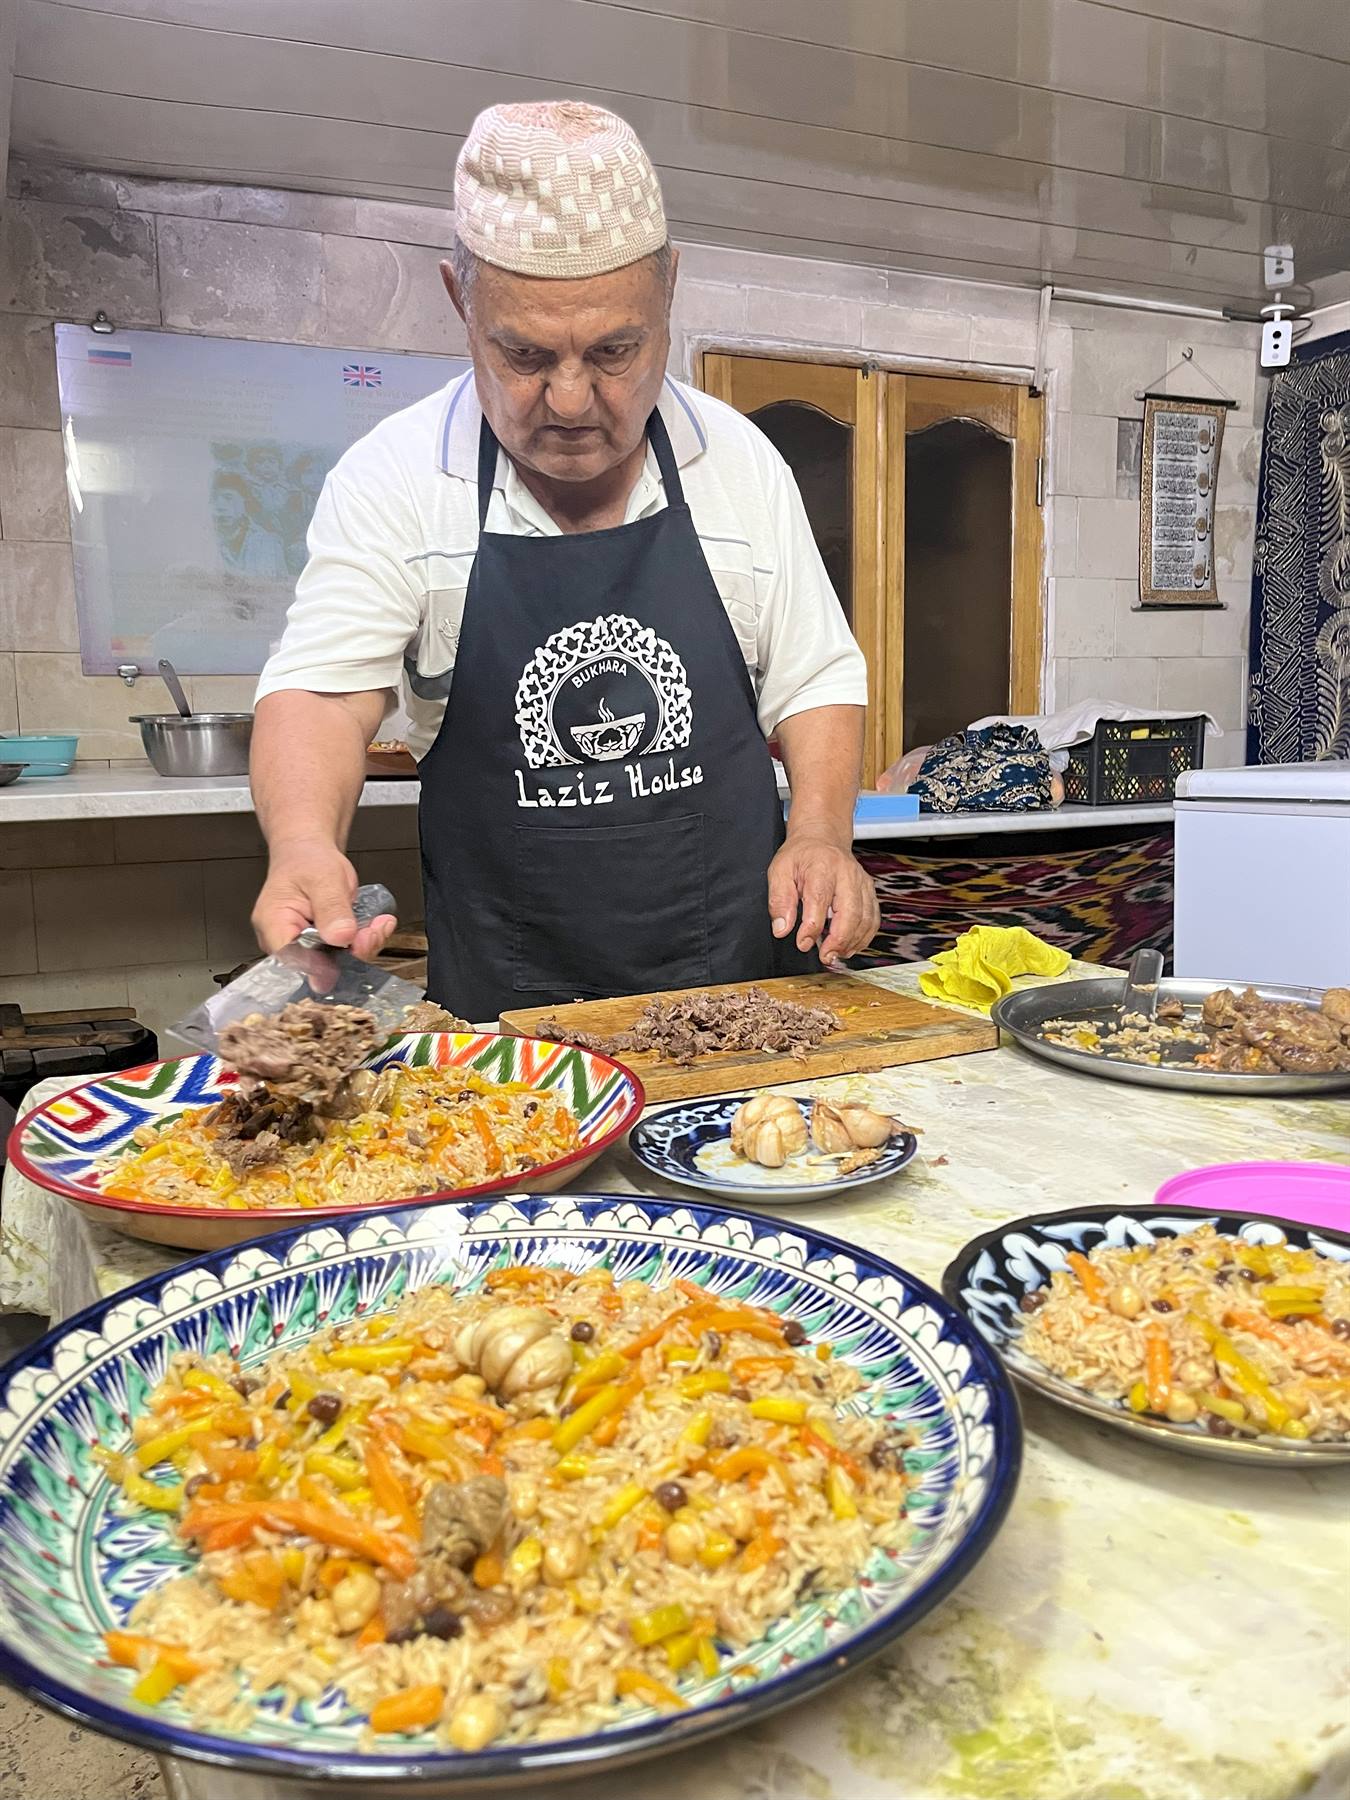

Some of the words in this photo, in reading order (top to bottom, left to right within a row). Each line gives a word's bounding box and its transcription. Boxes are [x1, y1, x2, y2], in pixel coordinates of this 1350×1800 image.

[571, 659, 628, 689] BUKHARA
[514, 769, 614, 808] Laziz
[625, 757, 704, 799] House
